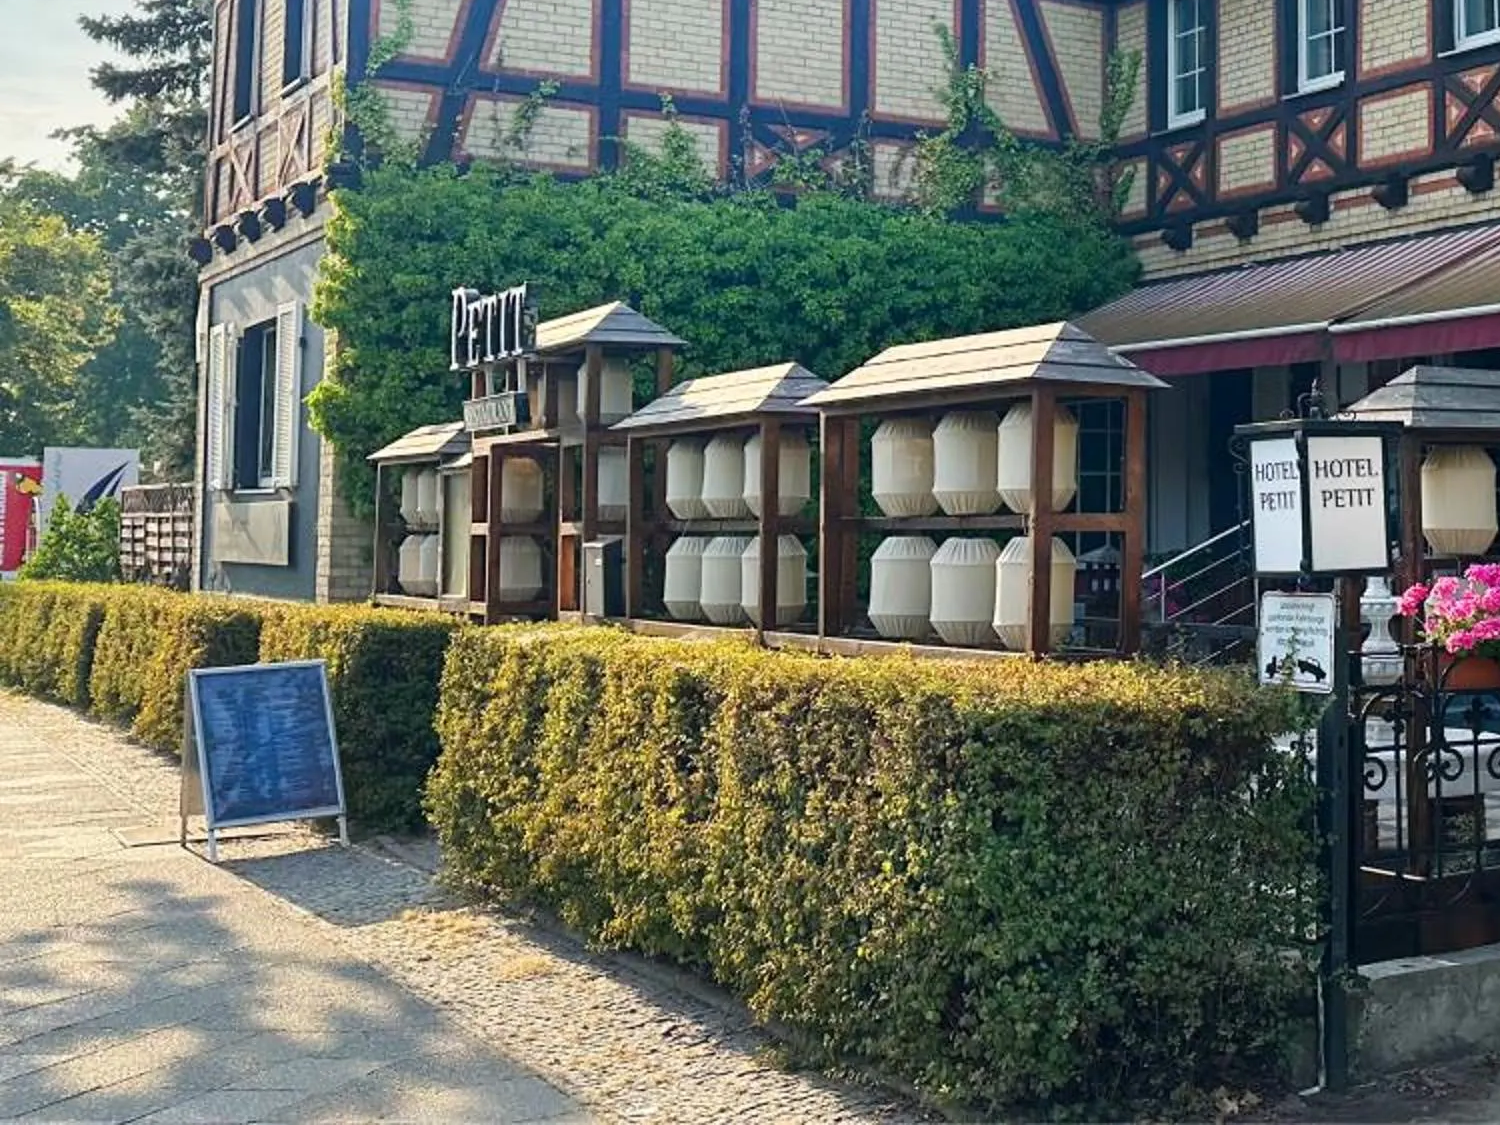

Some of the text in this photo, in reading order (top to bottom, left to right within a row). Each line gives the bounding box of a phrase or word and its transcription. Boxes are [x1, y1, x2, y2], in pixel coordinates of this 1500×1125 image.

[1255, 460, 1299, 482] HOTEL
[1314, 458, 1378, 479] HOTEL
[1260, 490, 1296, 511] PETIT
[1321, 487, 1375, 508] PETIT
